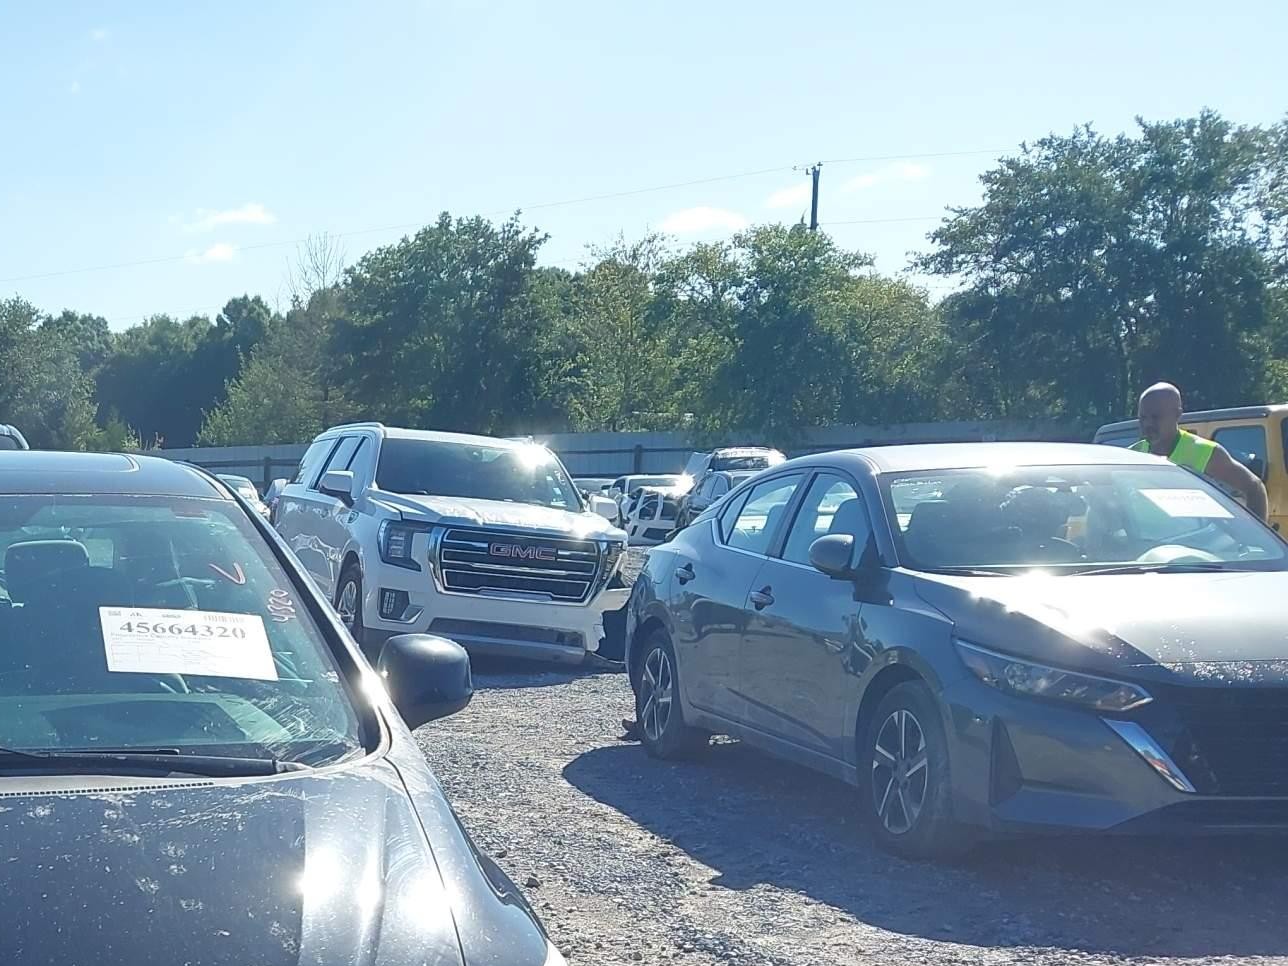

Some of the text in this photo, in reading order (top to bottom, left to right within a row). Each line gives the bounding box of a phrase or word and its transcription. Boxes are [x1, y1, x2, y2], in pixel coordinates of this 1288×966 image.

[488, 541, 558, 561] GMC
[266, 588, 297, 623] 4320
[119, 621, 247, 639] 45664320
